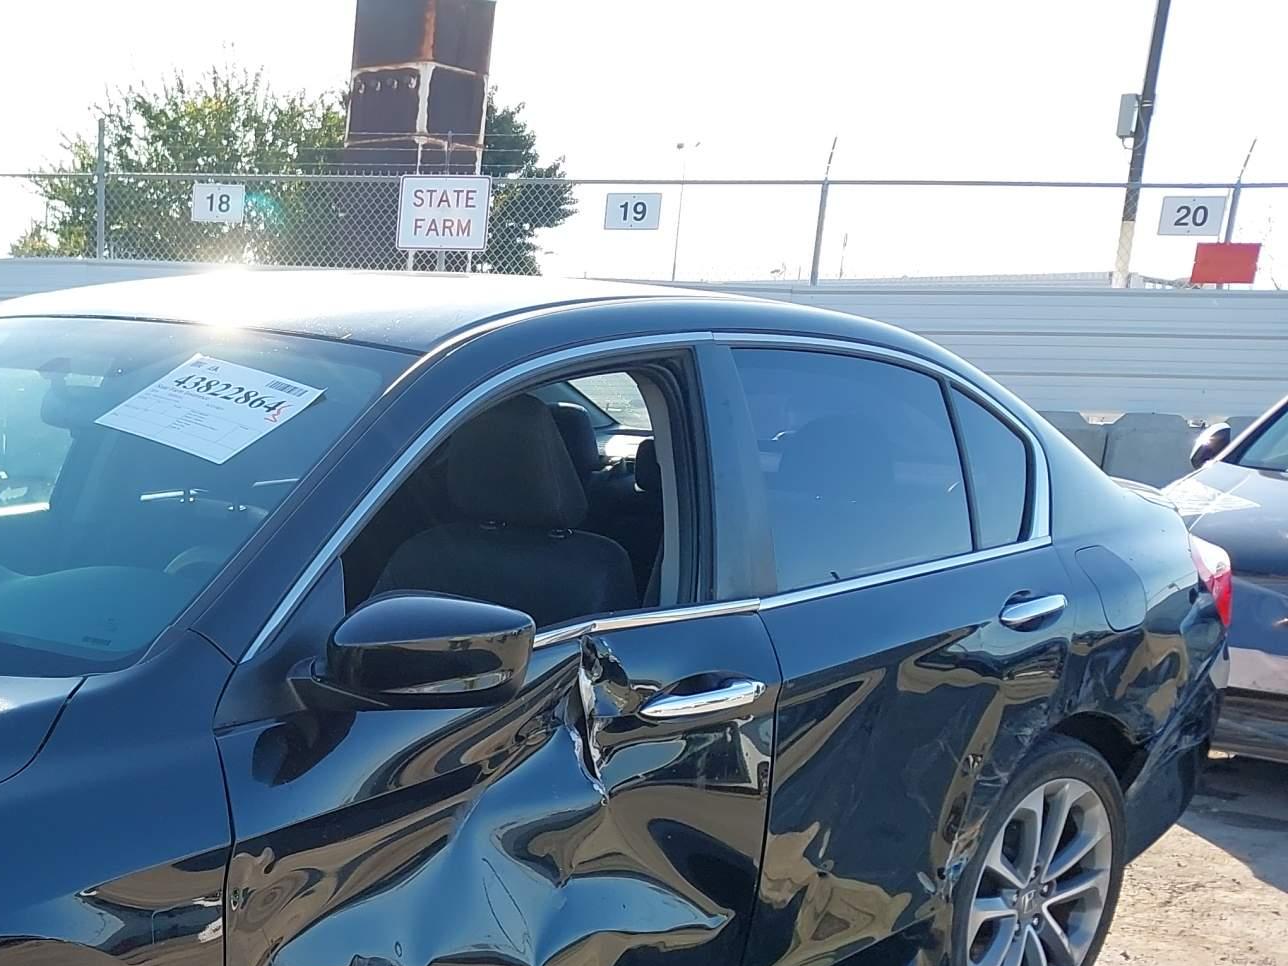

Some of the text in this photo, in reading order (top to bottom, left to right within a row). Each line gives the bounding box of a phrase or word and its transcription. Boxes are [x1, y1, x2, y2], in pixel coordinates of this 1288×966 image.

[206, 193, 231, 213] 18
[412, 189, 478, 208] STATE
[619, 201, 647, 222] 19
[1173, 205, 1209, 227] 20
[413, 218, 472, 237] FARM
[174, 374, 286, 413] 43822864
